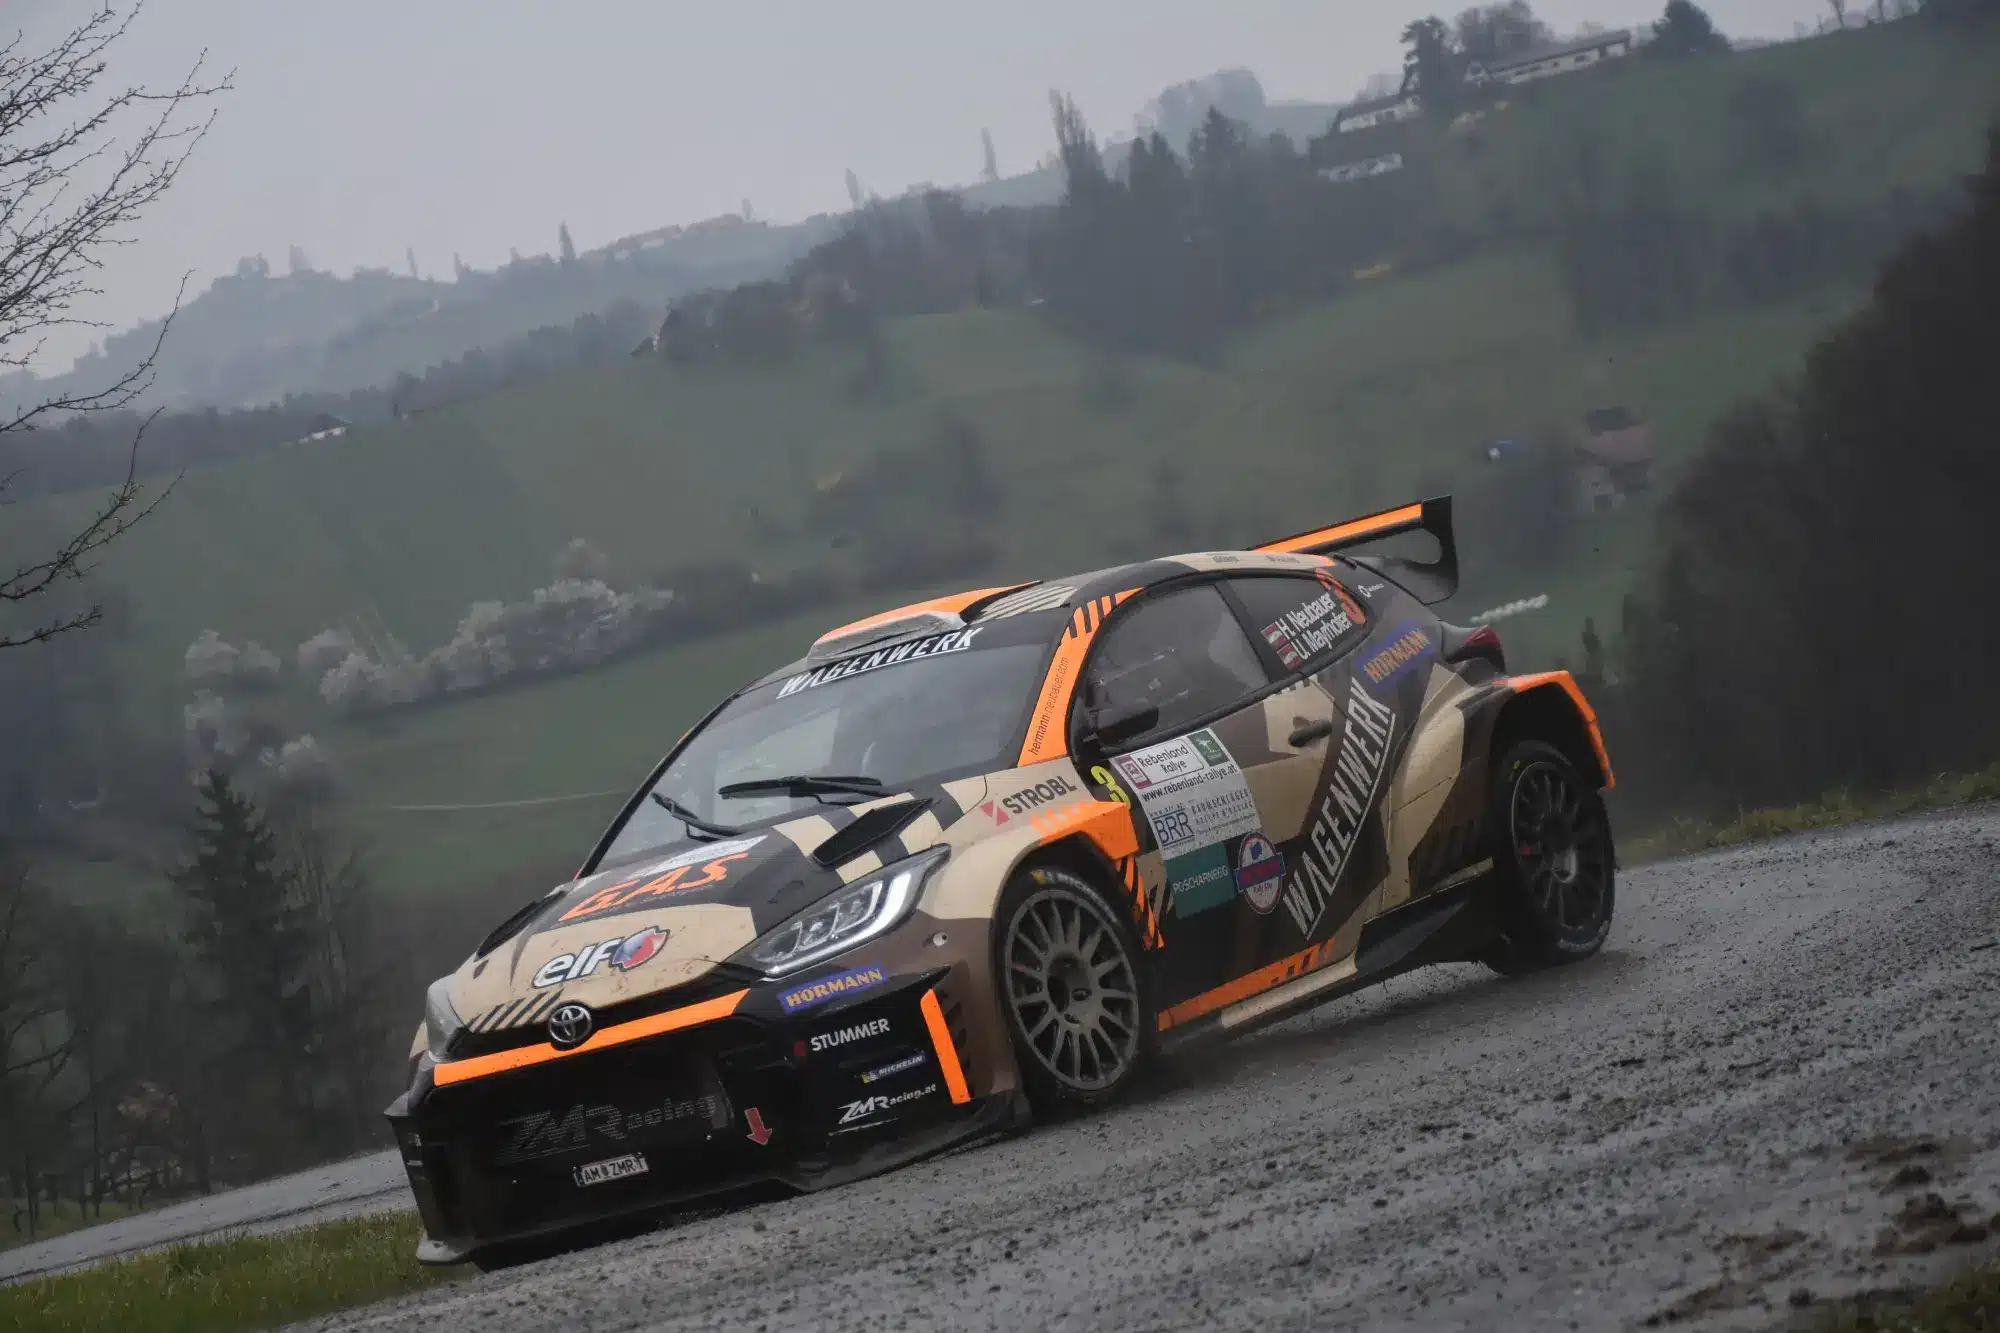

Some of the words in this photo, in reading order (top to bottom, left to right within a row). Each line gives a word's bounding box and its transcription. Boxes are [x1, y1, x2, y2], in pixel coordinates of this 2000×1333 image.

[1286, 592, 1336, 633] Neubauer
[776, 627, 984, 699] WAGENWERK
[1028, 657, 1068, 755] hermann-neubauer.com
[1137, 745, 1189, 767] Rebenland
[1161, 759, 1187, 773] Rallye
[1002, 775, 1077, 815] STROBL
[1090, 765, 1131, 810] 3
[1141, 764, 1238, 801] www.rebenland-rallye.at
[1283, 676, 1394, 940] WAGENWERK
[1153, 812, 1194, 844] BRR
[532, 936, 626, 989] elf
[810, 1018, 890, 1052] STUMMER
[878, 1055, 923, 1075] MICHELIN
[584, 1168, 600, 1183] AM
